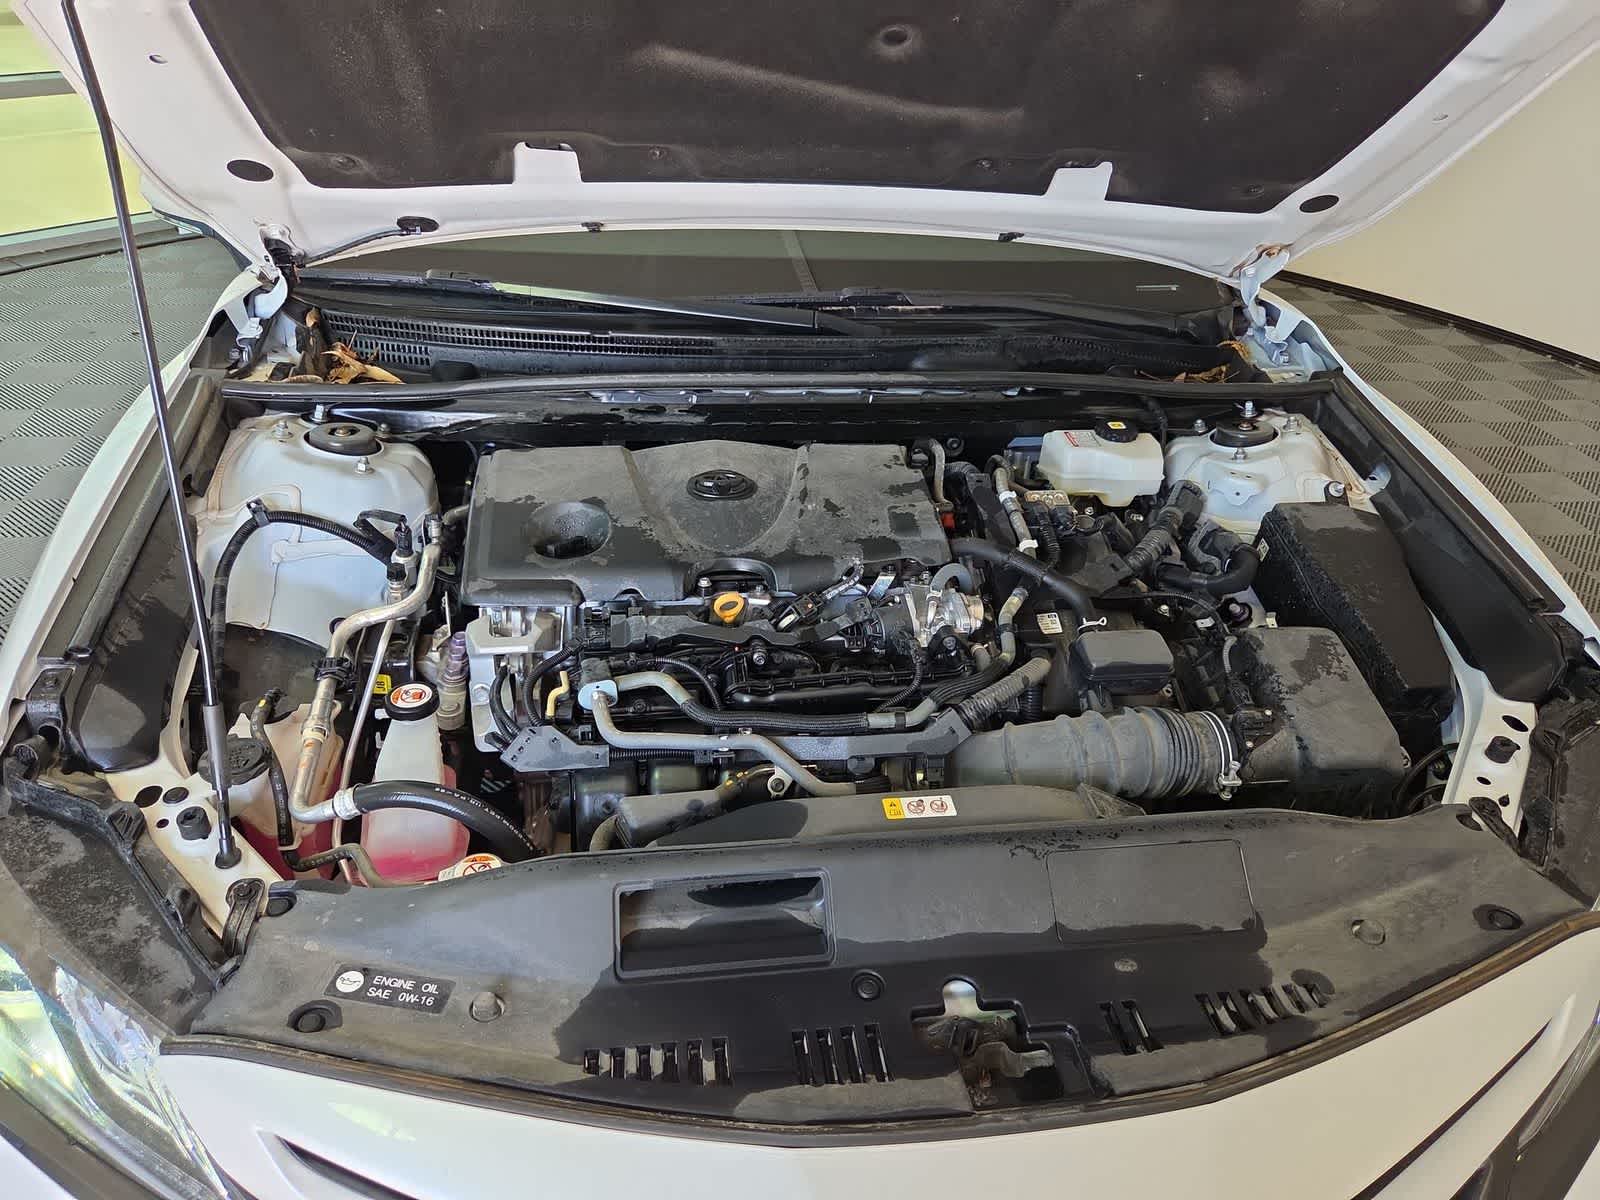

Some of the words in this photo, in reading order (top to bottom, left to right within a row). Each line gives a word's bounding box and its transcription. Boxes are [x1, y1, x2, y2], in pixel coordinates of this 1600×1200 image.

[373, 975, 416, 990] ENGINE
[421, 983, 439, 994] OIL
[367, 987, 392, 999] SAE
[398, 992, 435, 1006] 0W-16
